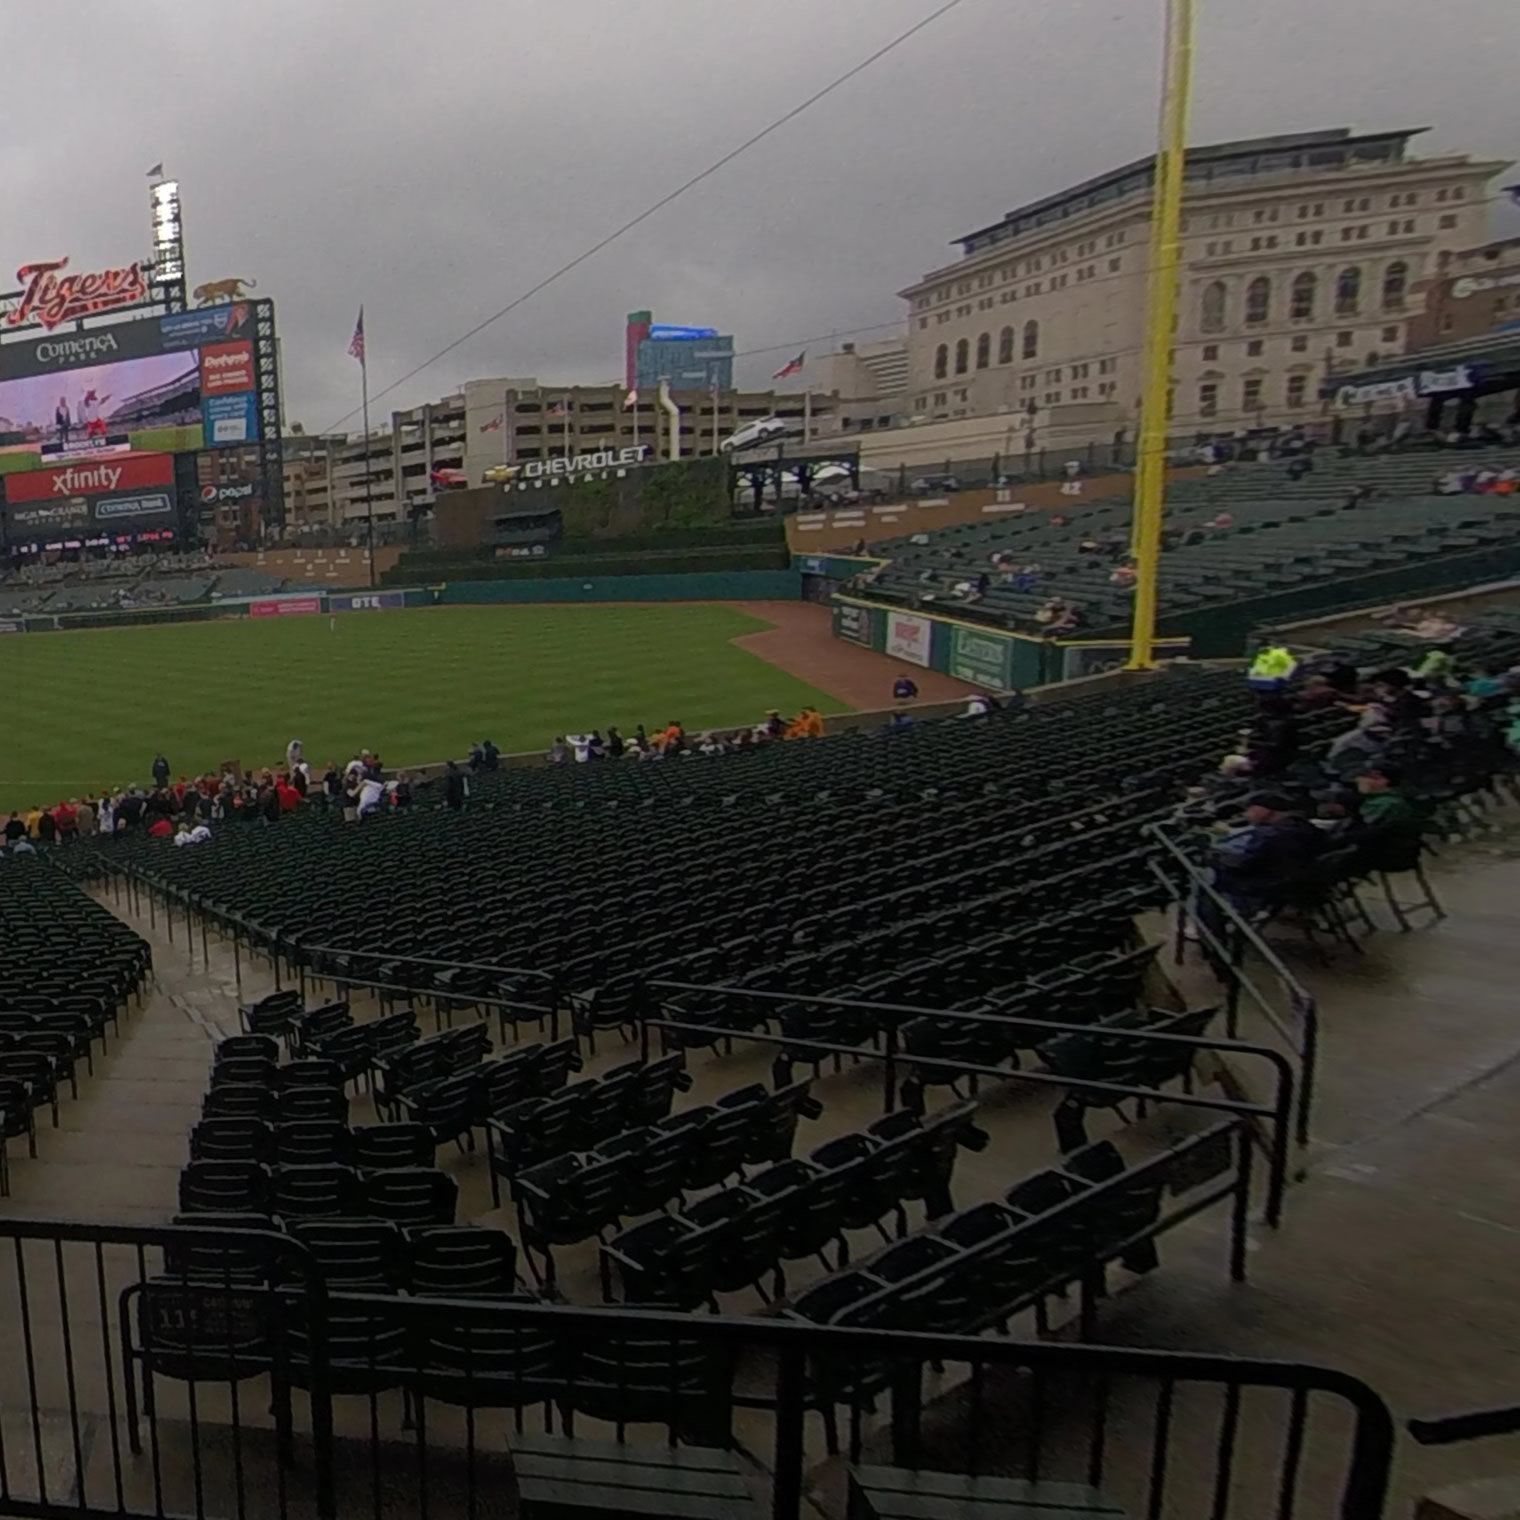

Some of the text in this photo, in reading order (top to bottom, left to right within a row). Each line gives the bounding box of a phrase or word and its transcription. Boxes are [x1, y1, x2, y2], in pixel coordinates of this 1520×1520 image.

[6, 256, 146, 329] Tigers
[525, 444, 648, 478] CHEVROLET
[52, 465, 123, 495] xfinity
[219, 483, 253, 502] pepsi
[351, 596, 381, 609] DTE
